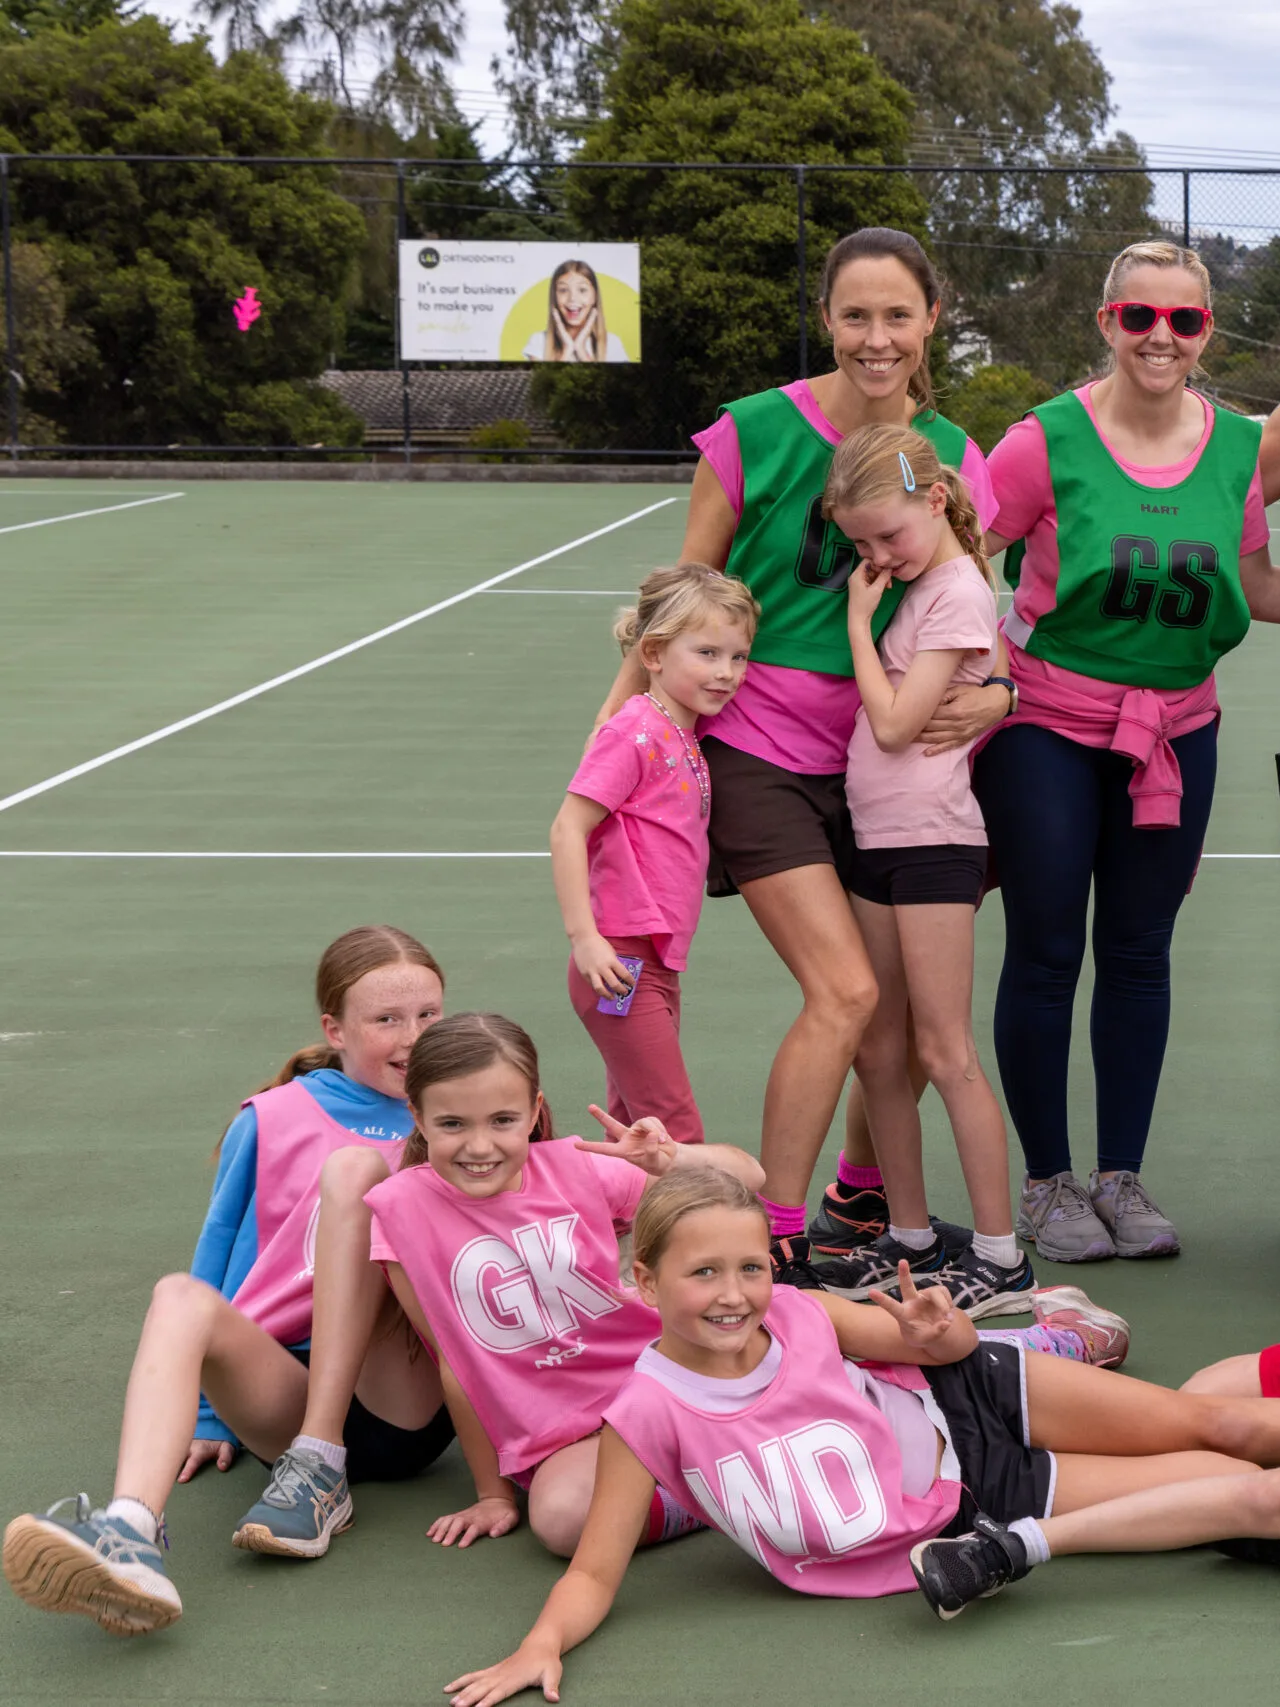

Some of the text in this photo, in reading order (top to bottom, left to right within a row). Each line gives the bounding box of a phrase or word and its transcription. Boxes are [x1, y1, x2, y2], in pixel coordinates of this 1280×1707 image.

[442, 254, 516, 263] ORTHODONTICS
[418, 282, 517, 295] It's our business
[418, 301, 494, 315] to make you
[1140, 503, 1180, 516] HART
[1101, 534, 1219, 630] GS
[363, 1126, 386, 1136] ALL
[450, 1213, 623, 1354] GK
[683, 1419, 887, 1573] WD
